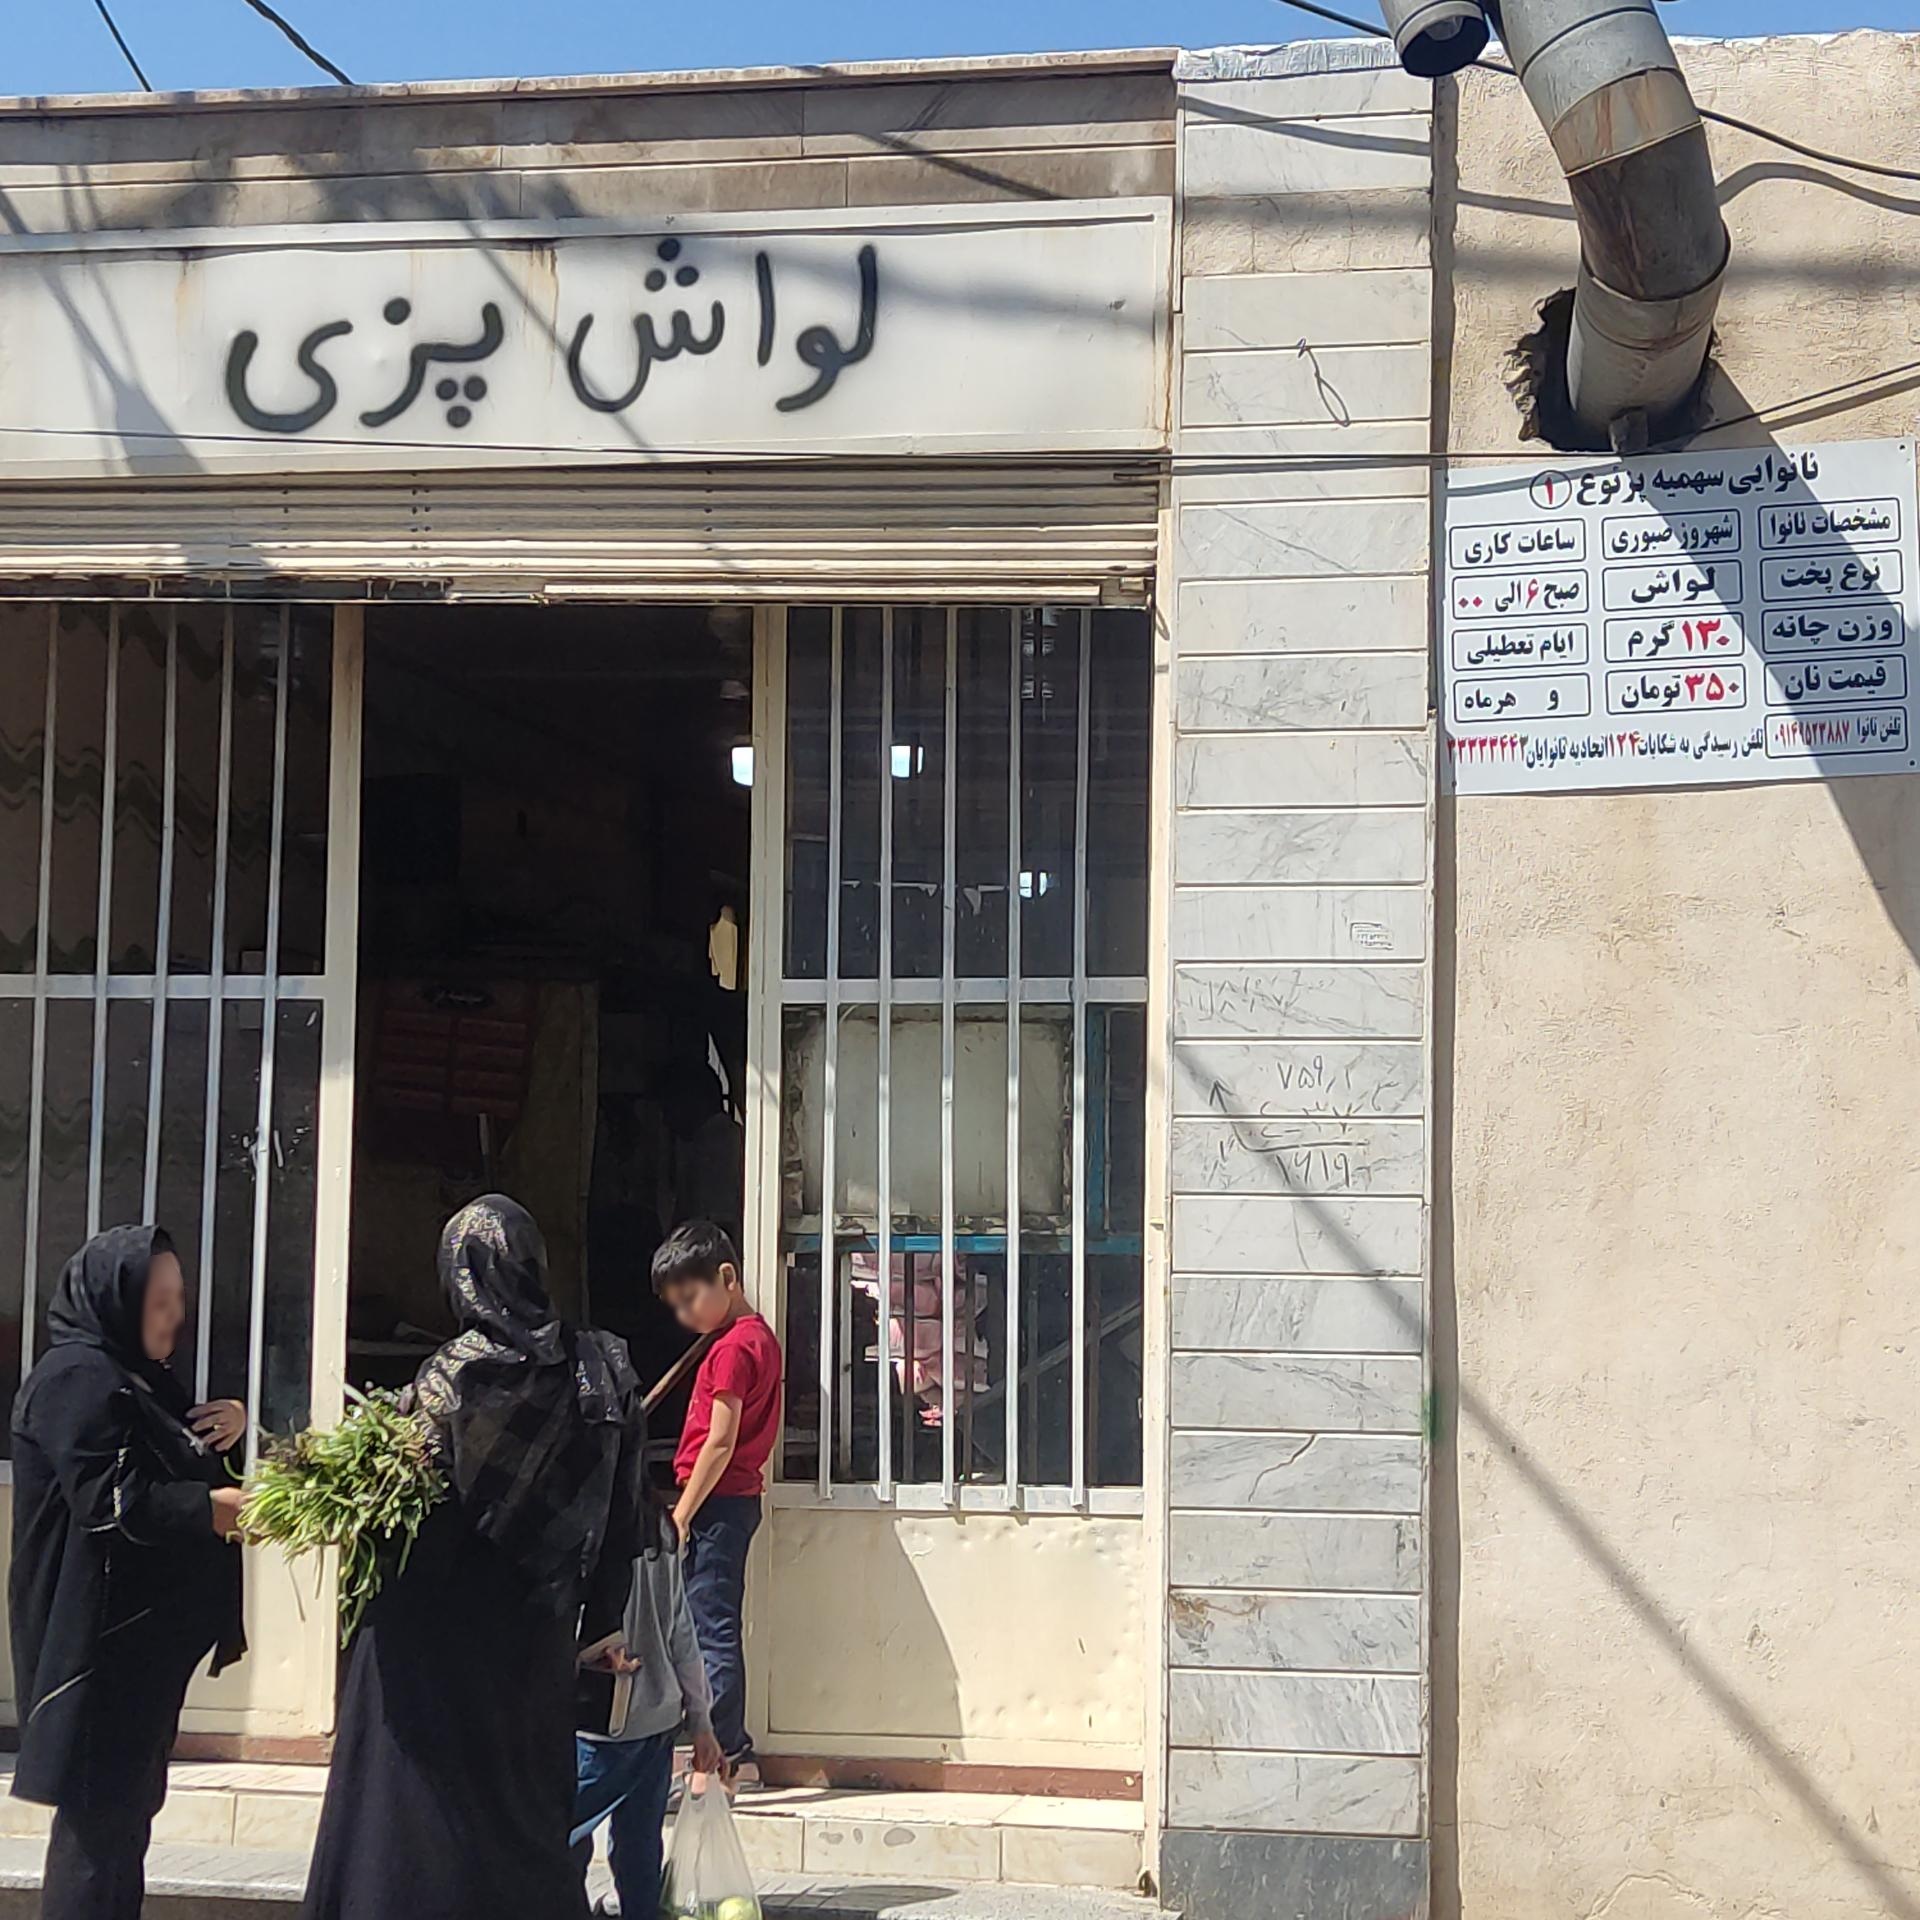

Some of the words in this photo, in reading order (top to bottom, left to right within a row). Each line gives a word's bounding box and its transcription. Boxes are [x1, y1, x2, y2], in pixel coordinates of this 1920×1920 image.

[568, 237, 878, 413] لواش
[225, 297, 504, 432] پزی
[1652, 467, 1724, 498] سهمیه
[1729, 452, 1819, 495] نانوایی
[1679, 513, 1733, 550] شهروز
[1770, 511, 1806, 545] نانوا
[1811, 507, 1891, 534] مشخصات
[1464, 531, 1512, 564] کاری
[1517, 527, 1576, 554] ساعات
[1611, 526, 1673, 554] صبوری
[1631, 566, 1716, 604] لواش
[1780, 561, 1834, 594] پخت
[1839, 557, 1881, 591] نوع
[1495, 580, 1522, 612] الی
[1543, 582, 1580, 610] صبح
[1627, 620, 1675, 658] گرم
[1681, 618, 1731, 652] ۱۳۰
[1772, 614, 1830, 645] چانه
[1837, 615, 1894, 642] وزن
[1467, 633, 1535, 665] تعطیلی
[1540, 630, 1574, 661] ایام
[1621, 674, 1682, 709] تومان
[1684, 673, 1740, 703] ۳۵۰
[1784, 664, 1822, 701] نان
[1828, 659, 1887, 695] قیمت
[1546, 689, 1560, 711] و
[1693, 731, 1739, 760] رسیدگی
[1743, 728, 1764, 757] تلفن
[1856, 717, 1878, 743] نانوا
[1879, 716, 1902, 743] تلفن
[1679, 735, 1690, 759] به
